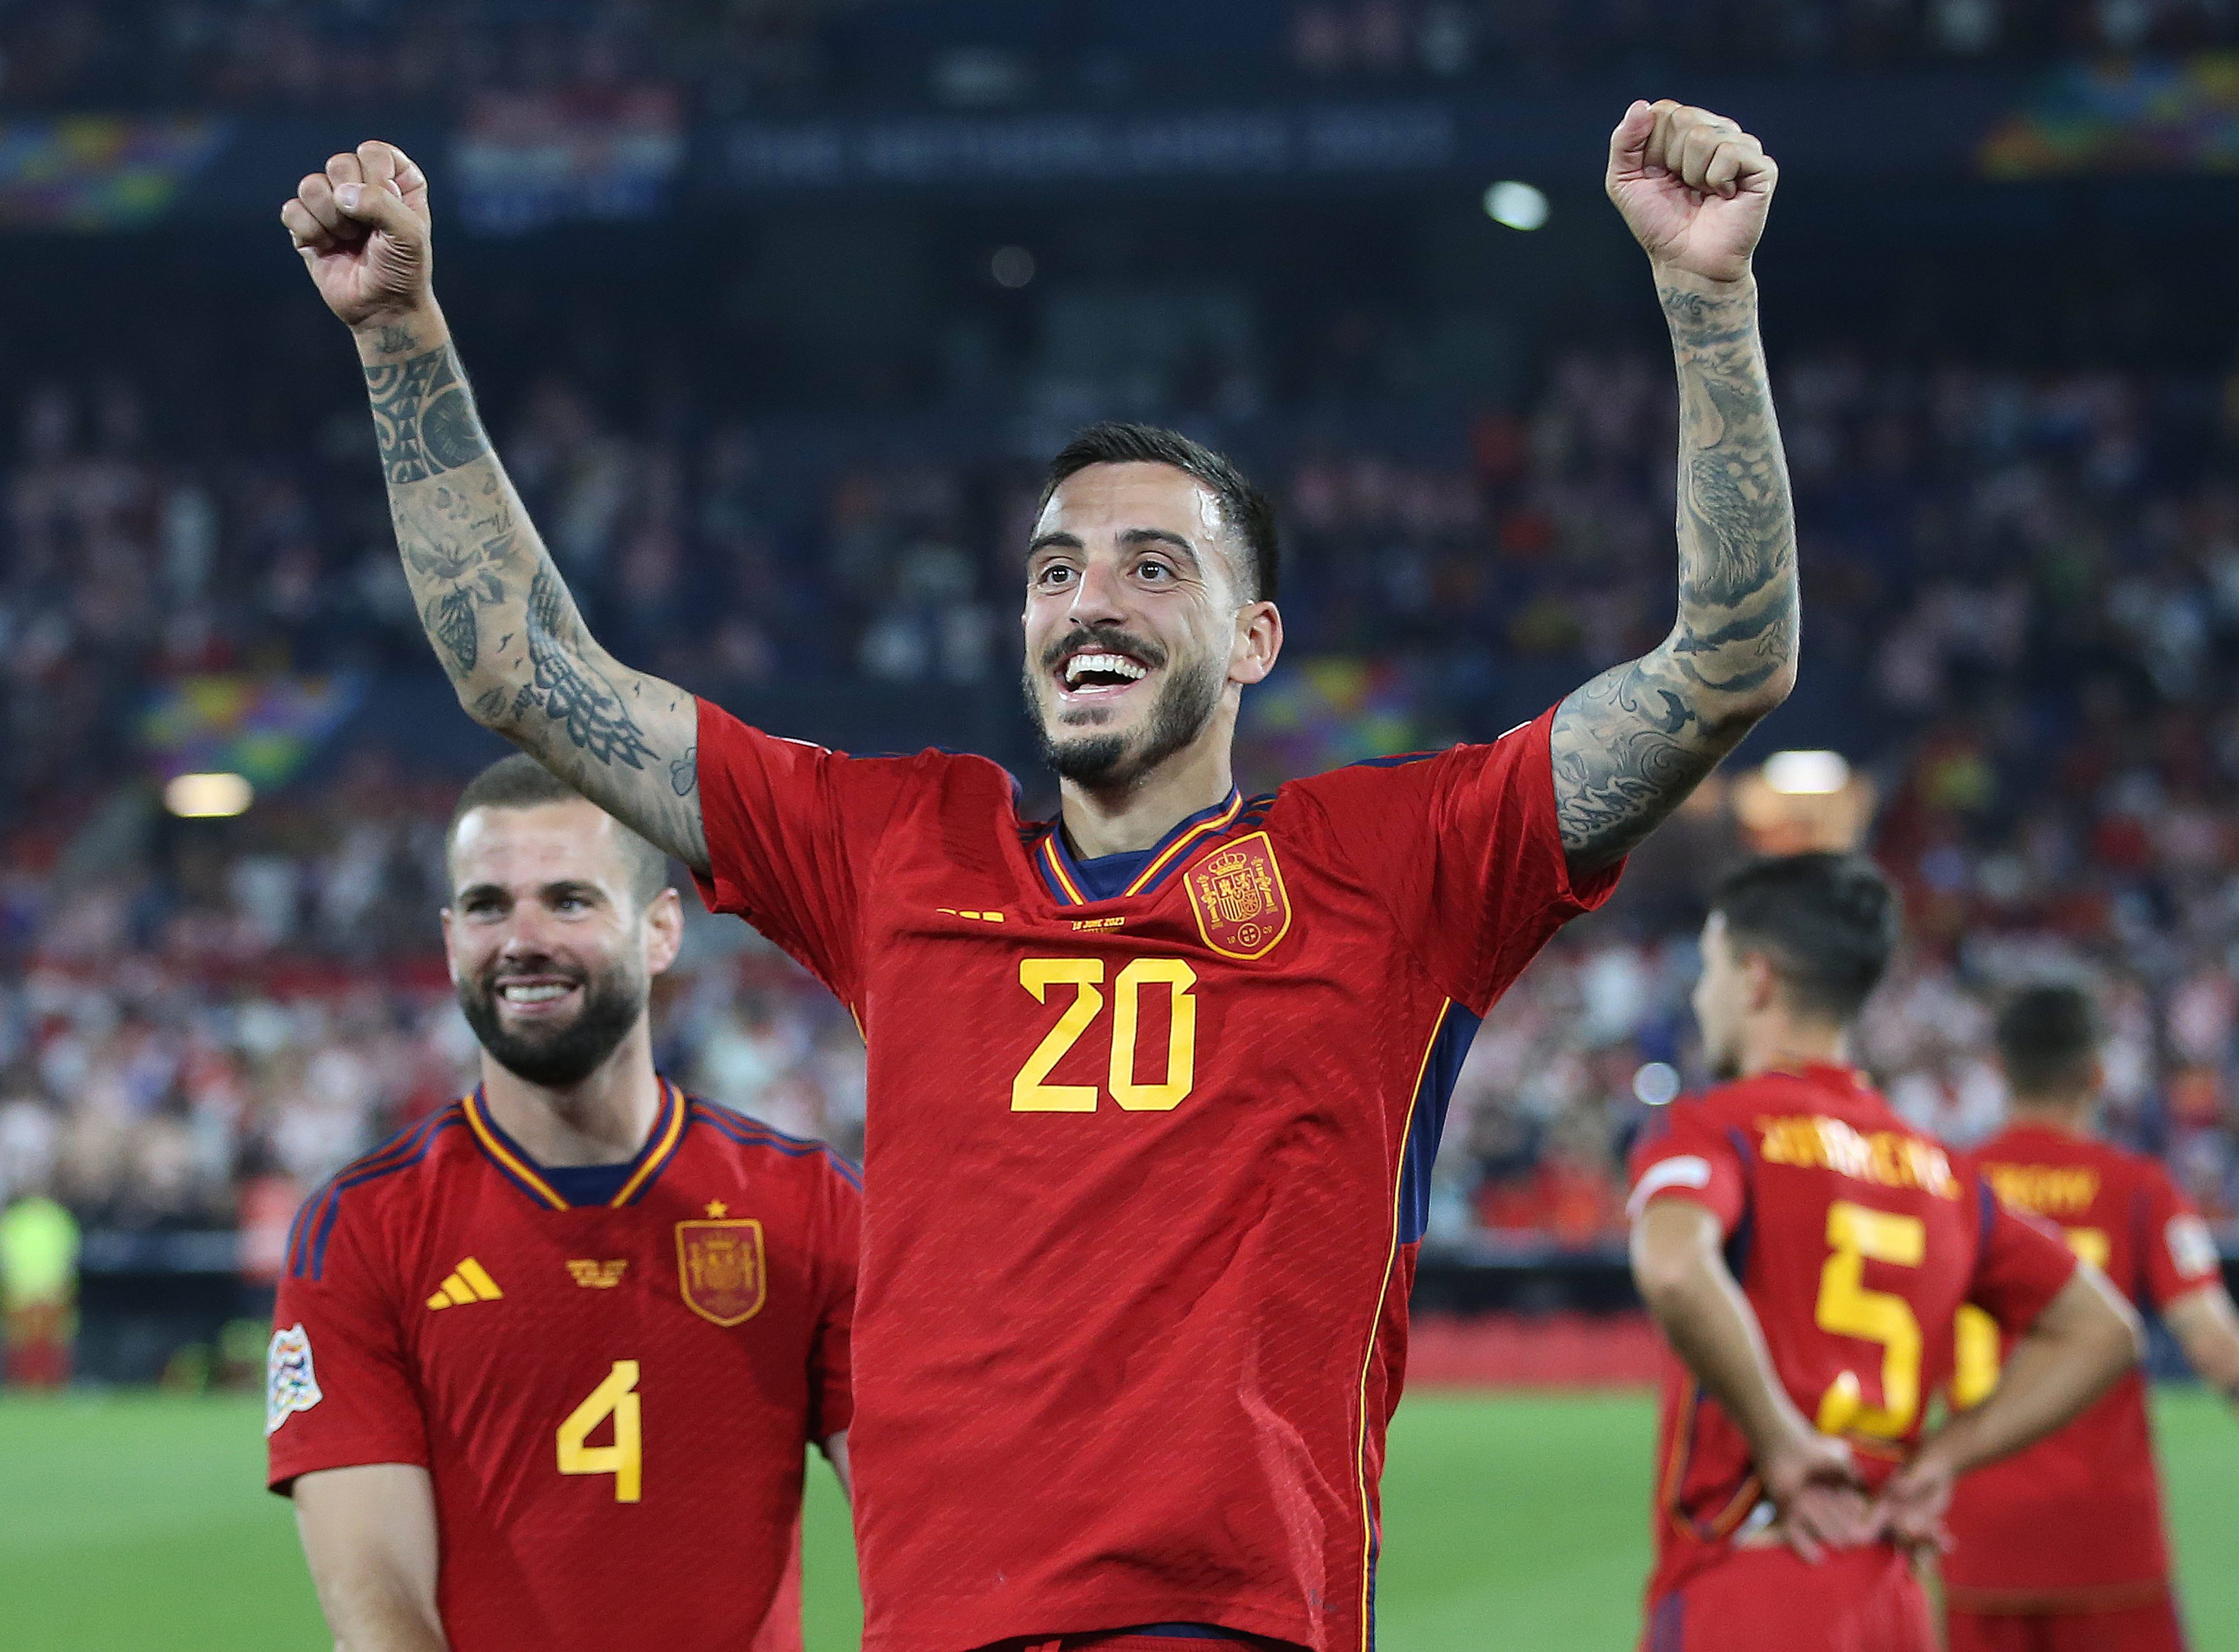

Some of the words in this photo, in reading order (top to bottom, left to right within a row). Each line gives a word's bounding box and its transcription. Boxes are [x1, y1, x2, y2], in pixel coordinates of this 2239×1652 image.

[1010, 958, 1197, 1112] 20
[1816, 1202, 1924, 1437] 5
[556, 1360, 641, 1503] 4
